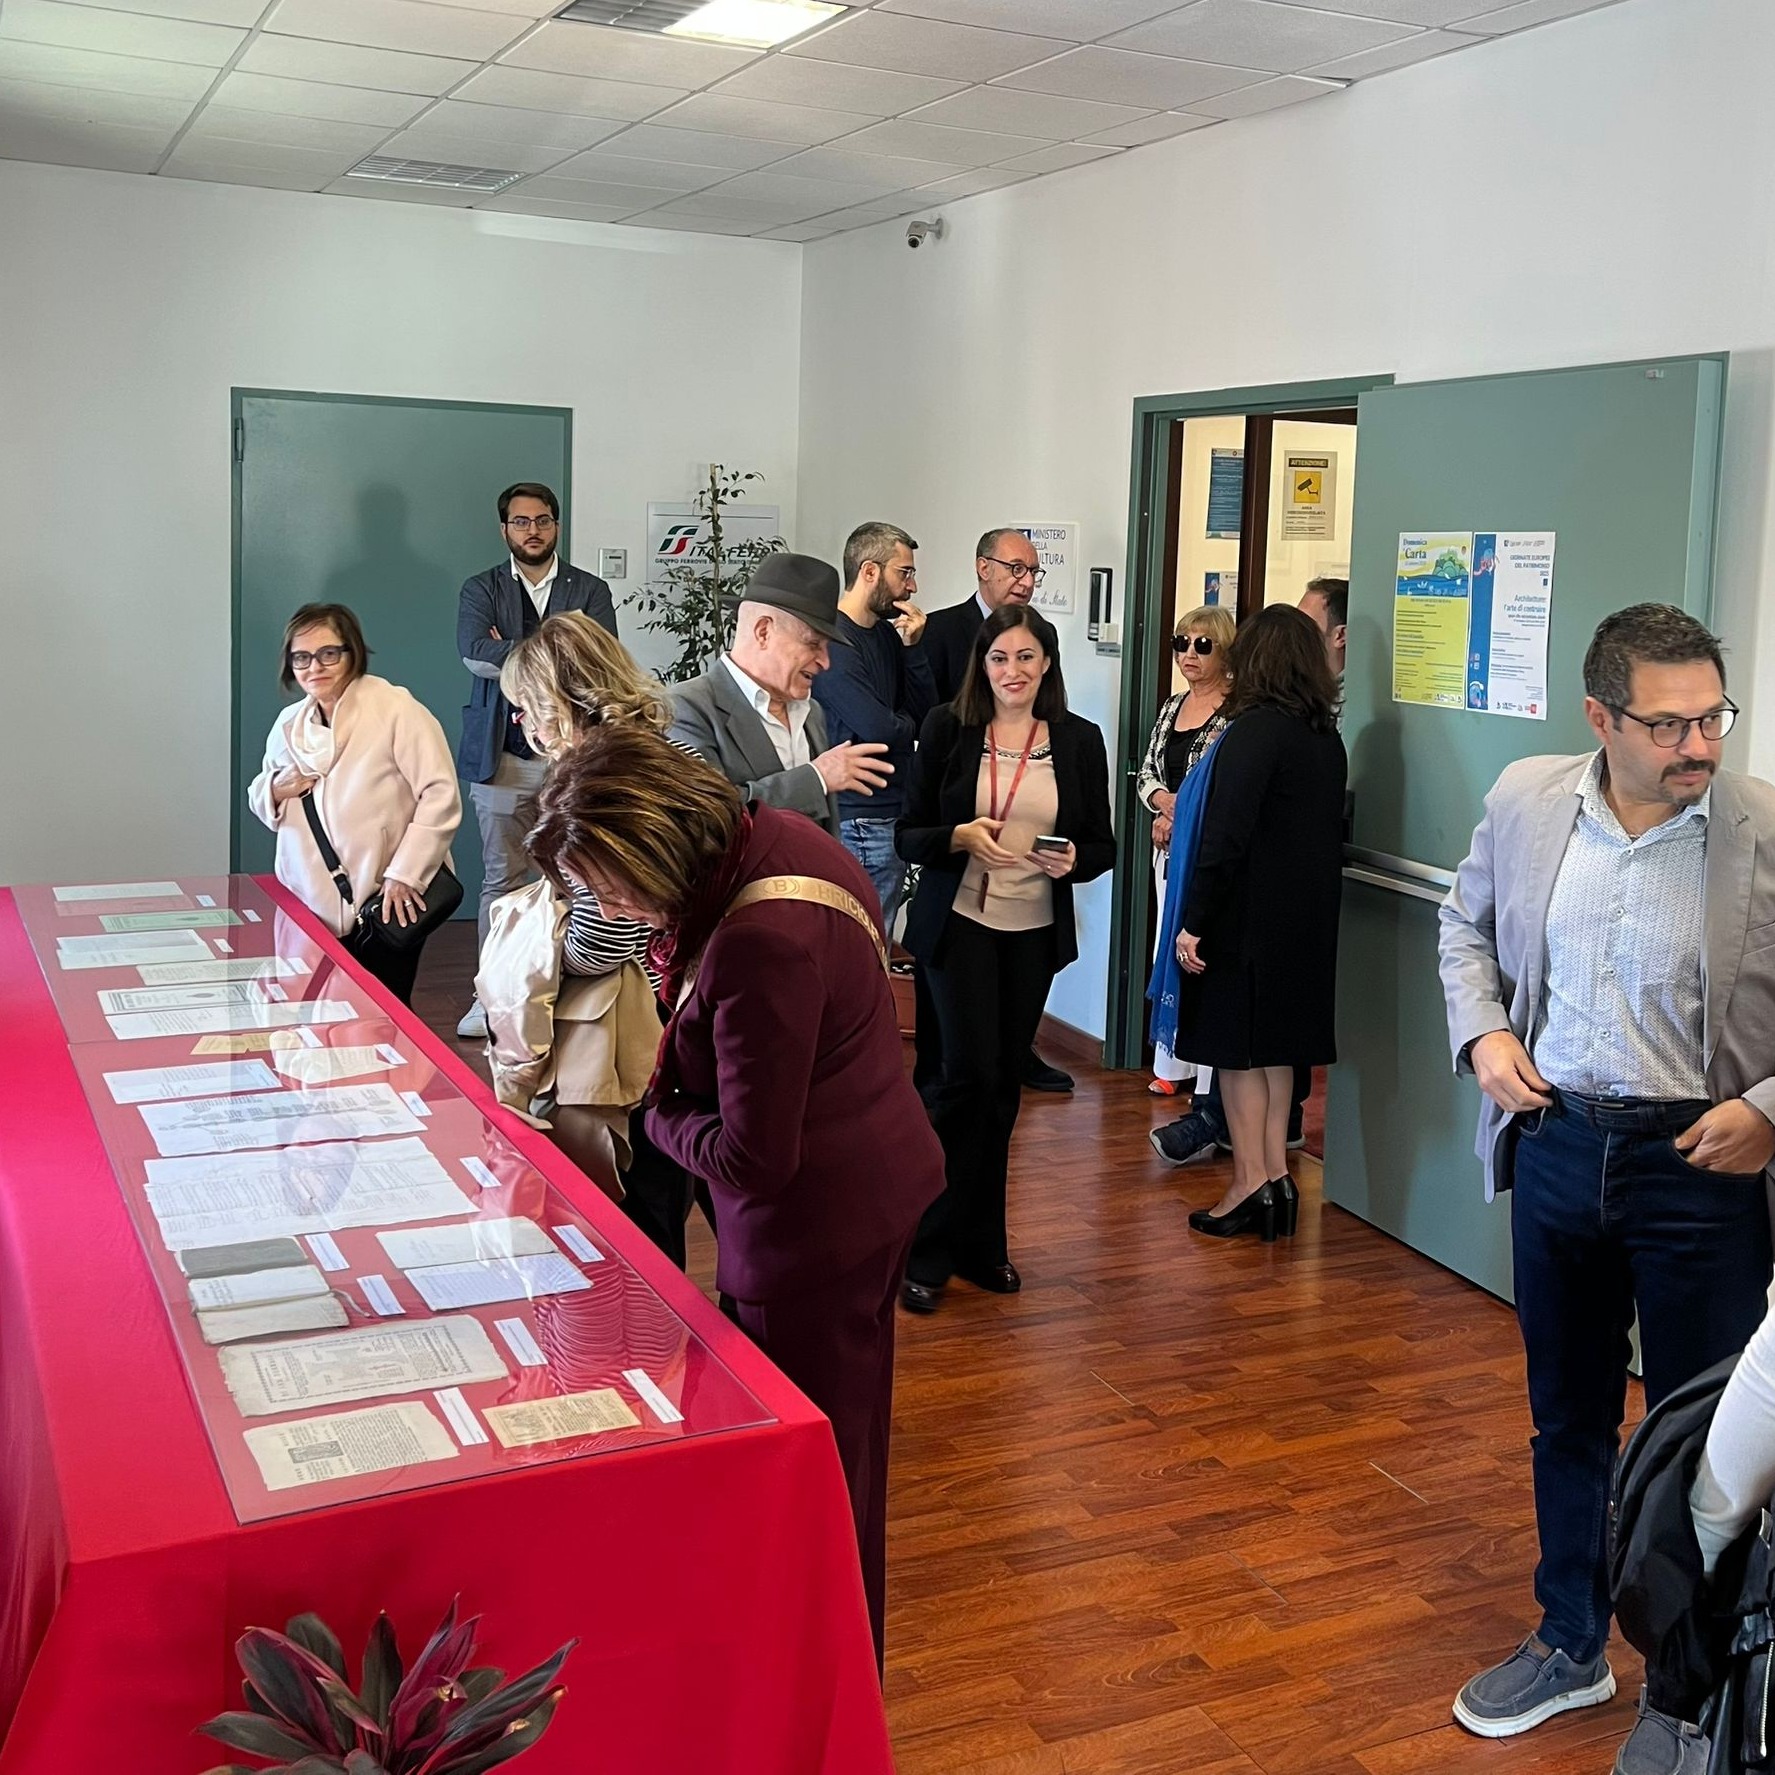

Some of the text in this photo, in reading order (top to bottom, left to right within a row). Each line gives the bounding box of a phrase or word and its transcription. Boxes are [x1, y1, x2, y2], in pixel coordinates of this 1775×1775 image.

[1033, 529, 1066, 540] MINISTERO
[1037, 553, 1065, 565] LTURA
[1405, 547, 1427, 559] Carta
